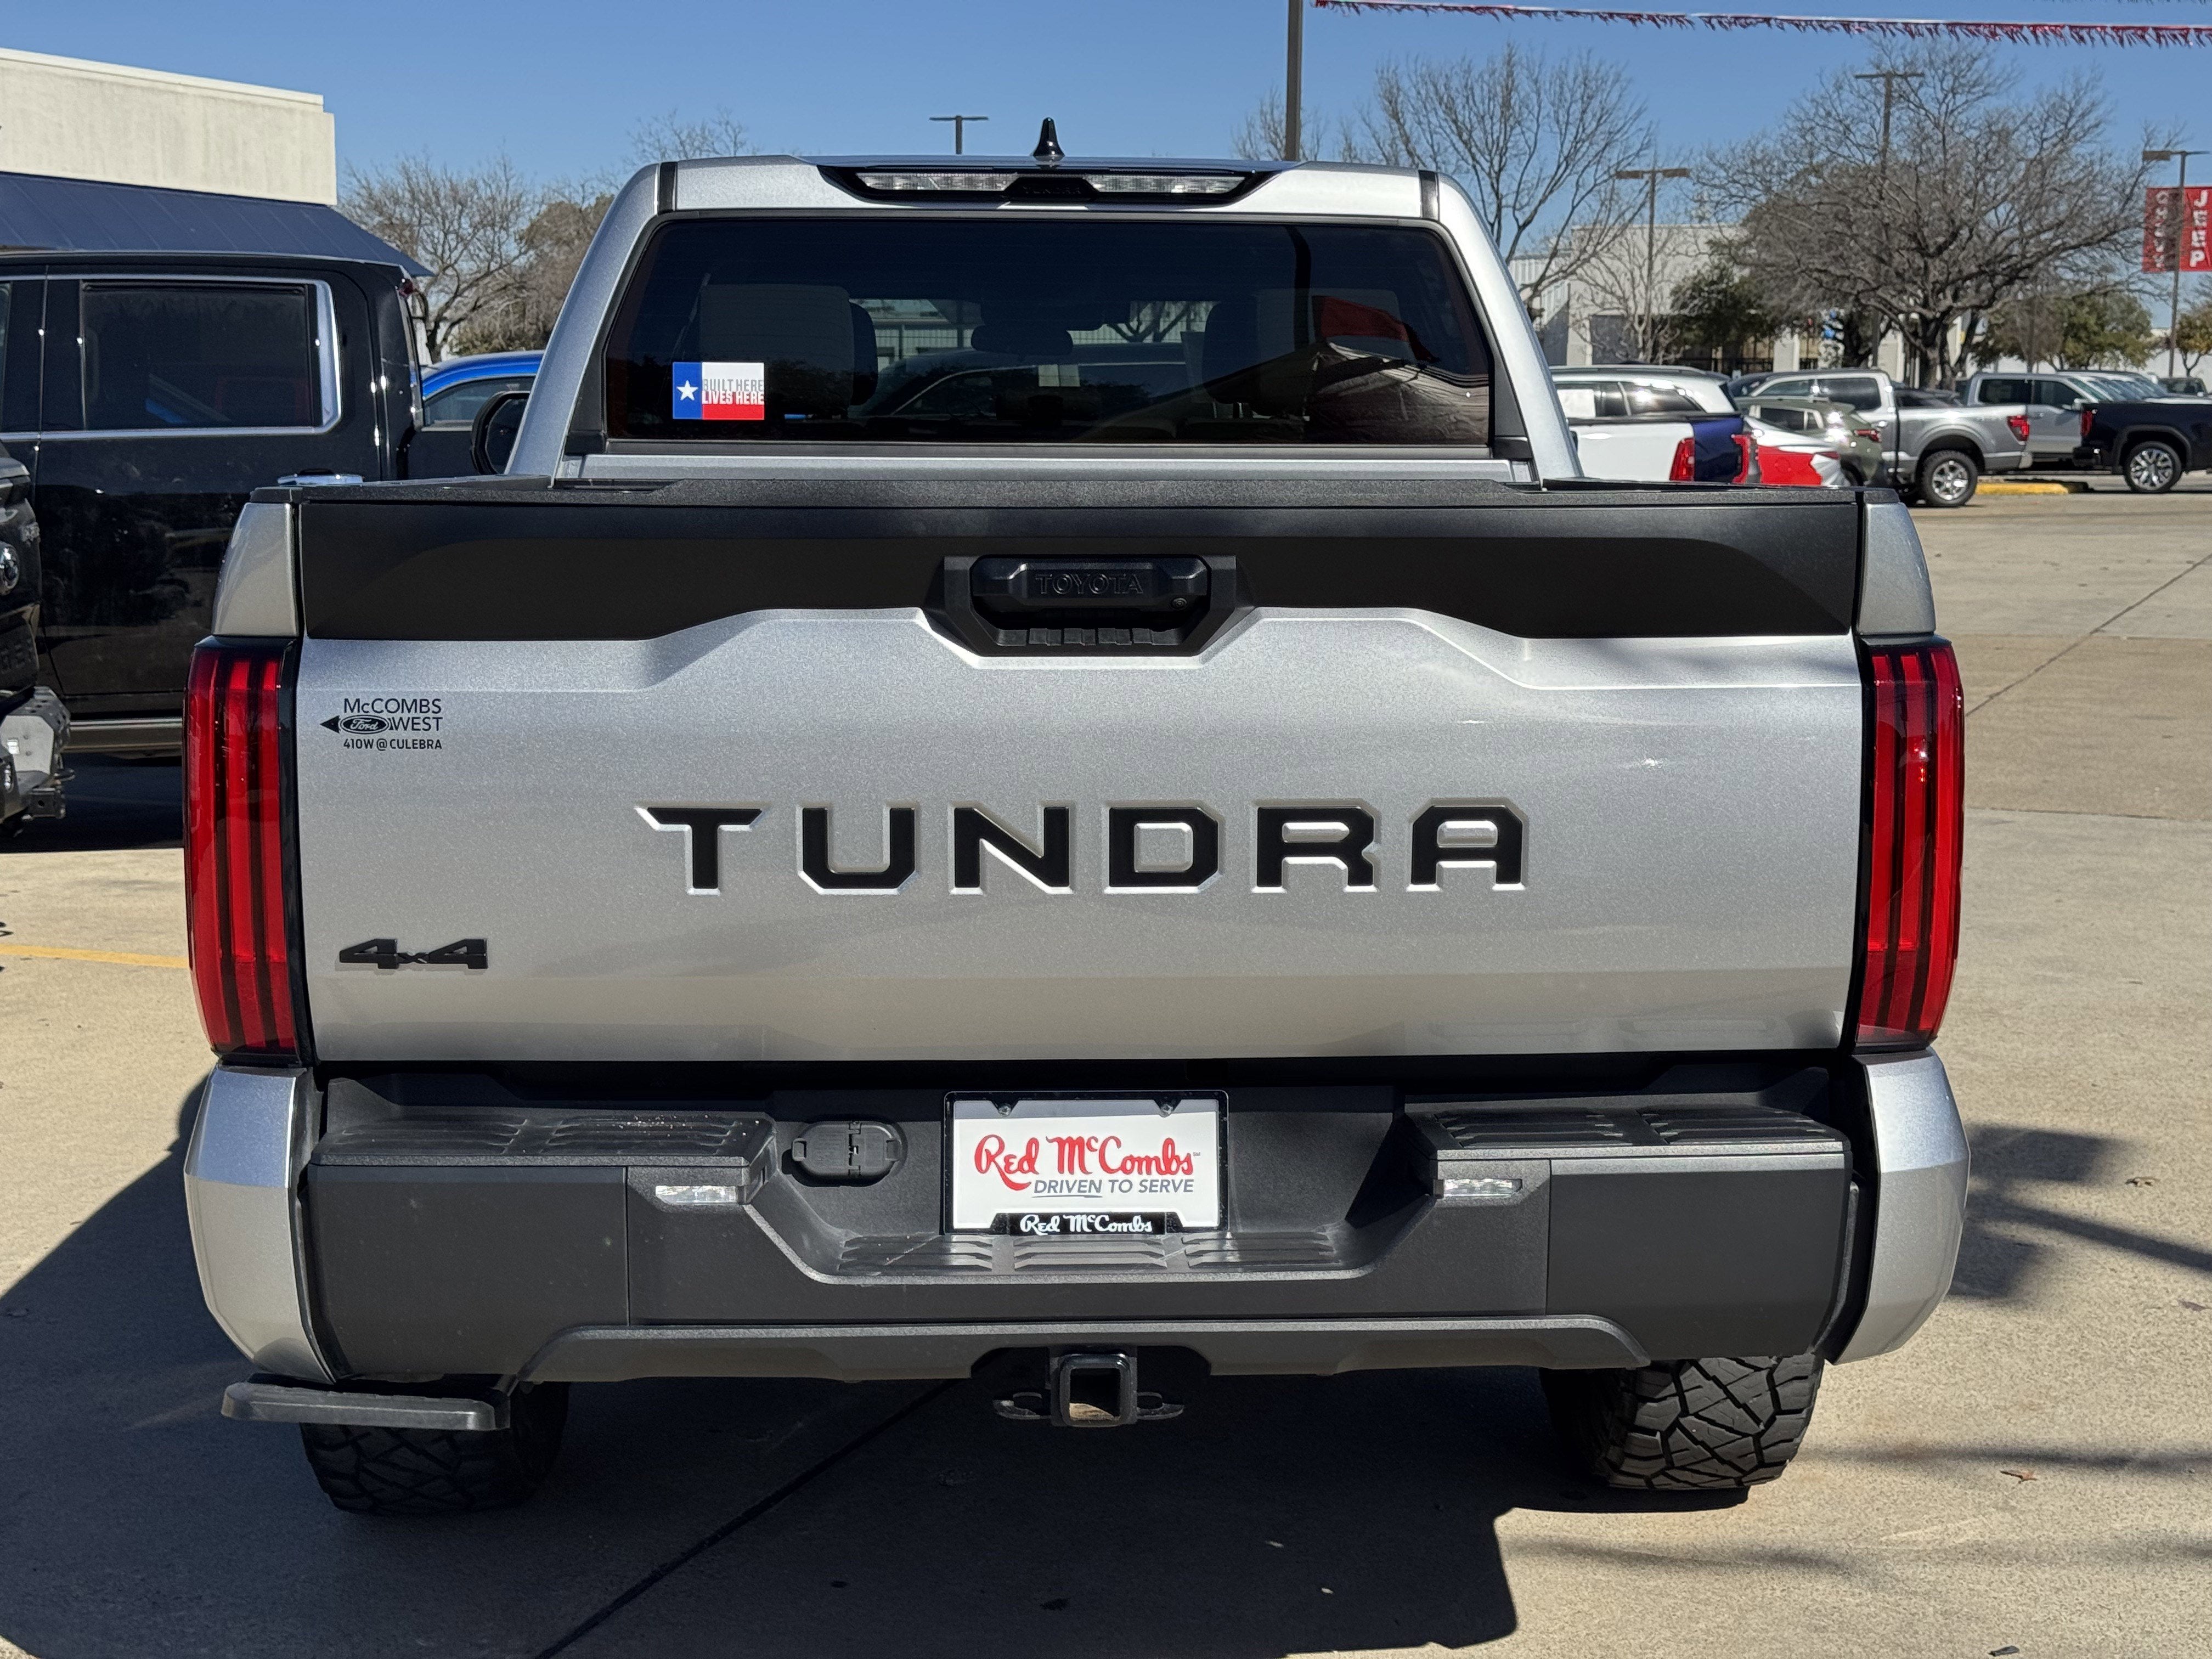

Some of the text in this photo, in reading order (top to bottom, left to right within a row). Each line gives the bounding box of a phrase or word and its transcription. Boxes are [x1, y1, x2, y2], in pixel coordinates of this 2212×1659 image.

[2190, 189, 2208, 268] JEEP
[703, 379, 764, 392] BUILT HERE
[702, 391, 764, 405] LIVES HERE
[1035, 573, 1143, 595] TOYOTA
[343, 698, 442, 714] McCOMBS
[349, 718, 379, 731] Ford
[391, 716, 443, 731] WEST
[636, 801, 1527, 894] TUNDRA
[974, 1134, 1040, 1191] Red
[1046, 1136, 1194, 1175] McCombs
[1034, 1179, 1194, 1194] DRIVEN TO SERVE
[1020, 1214, 1153, 1235] Red McCombs
